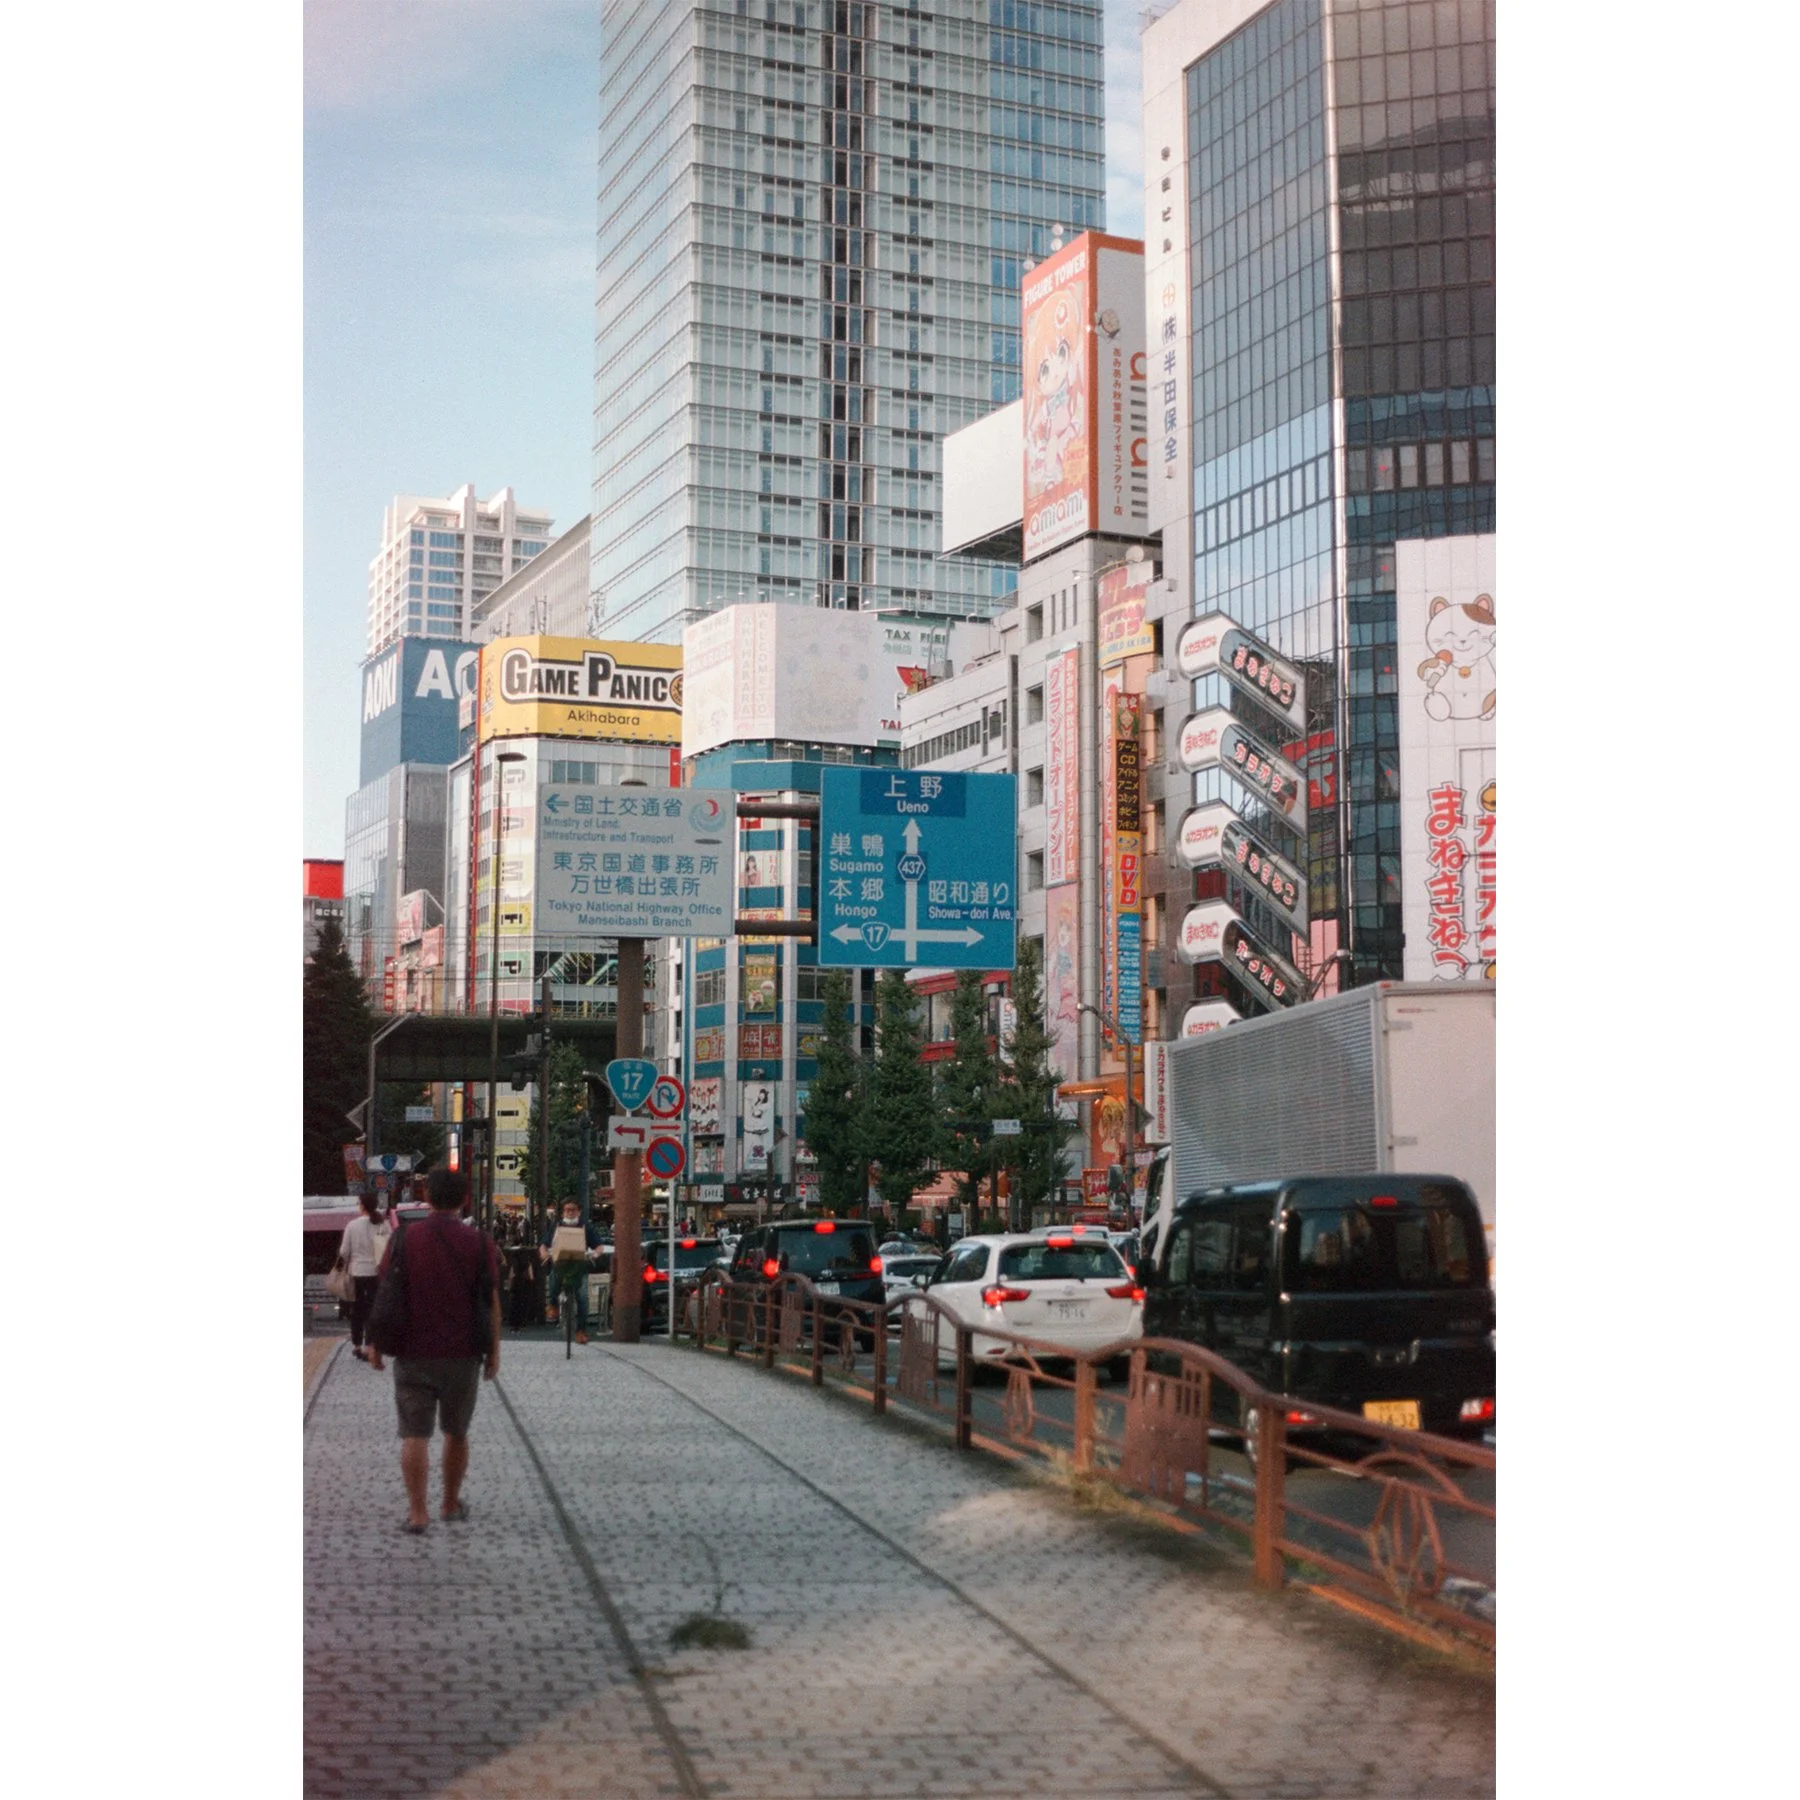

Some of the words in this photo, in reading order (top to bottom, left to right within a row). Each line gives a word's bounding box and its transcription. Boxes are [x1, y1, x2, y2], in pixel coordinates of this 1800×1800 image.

[880, 629, 911, 641] TAX
[505, 653, 580, 697] GAME
[588, 656, 668, 701] PANIC
[363, 651, 397, 724] AOKI
[567, 710, 641, 727] Akihabara
[1120, 754, 1136, 765] CD
[884, 774, 942, 799] 上野
[574, 795, 683, 817] 国土交通省
[896, 800, 929, 813] Ueno
[543, 816, 580, 829] Ministry
[583, 816, 593, 828] of
[543, 829, 606, 842] Infrastructure
[609, 831, 627, 843] and
[630, 832, 674, 845] Transport
[829, 832, 884, 857] 巣鴨
[553, 851, 719, 875] 東京国道事務所
[829, 859, 884, 873] Sugamo
[901, 861, 922, 875] 437
[570, 874, 701, 897] 万世橋出張所
[828, 877, 884, 901] 本郷
[1119, 854, 1137, 907] DVD
[928, 880, 1009, 905] 昭和通り
[548, 899, 582, 913] Tokyo
[586, 901, 633, 913] National
[637, 902, 684, 917] Highway
[688, 903, 723, 916] Office
[834, 903, 878, 919] Hongo
[992, 908, 1014, 921] Ave.
[578, 913, 648, 926] Manseibashi
[652, 915, 692, 927] Branch
[867, 926, 882, 943] 17
[621, 1072, 643, 1091] 17
